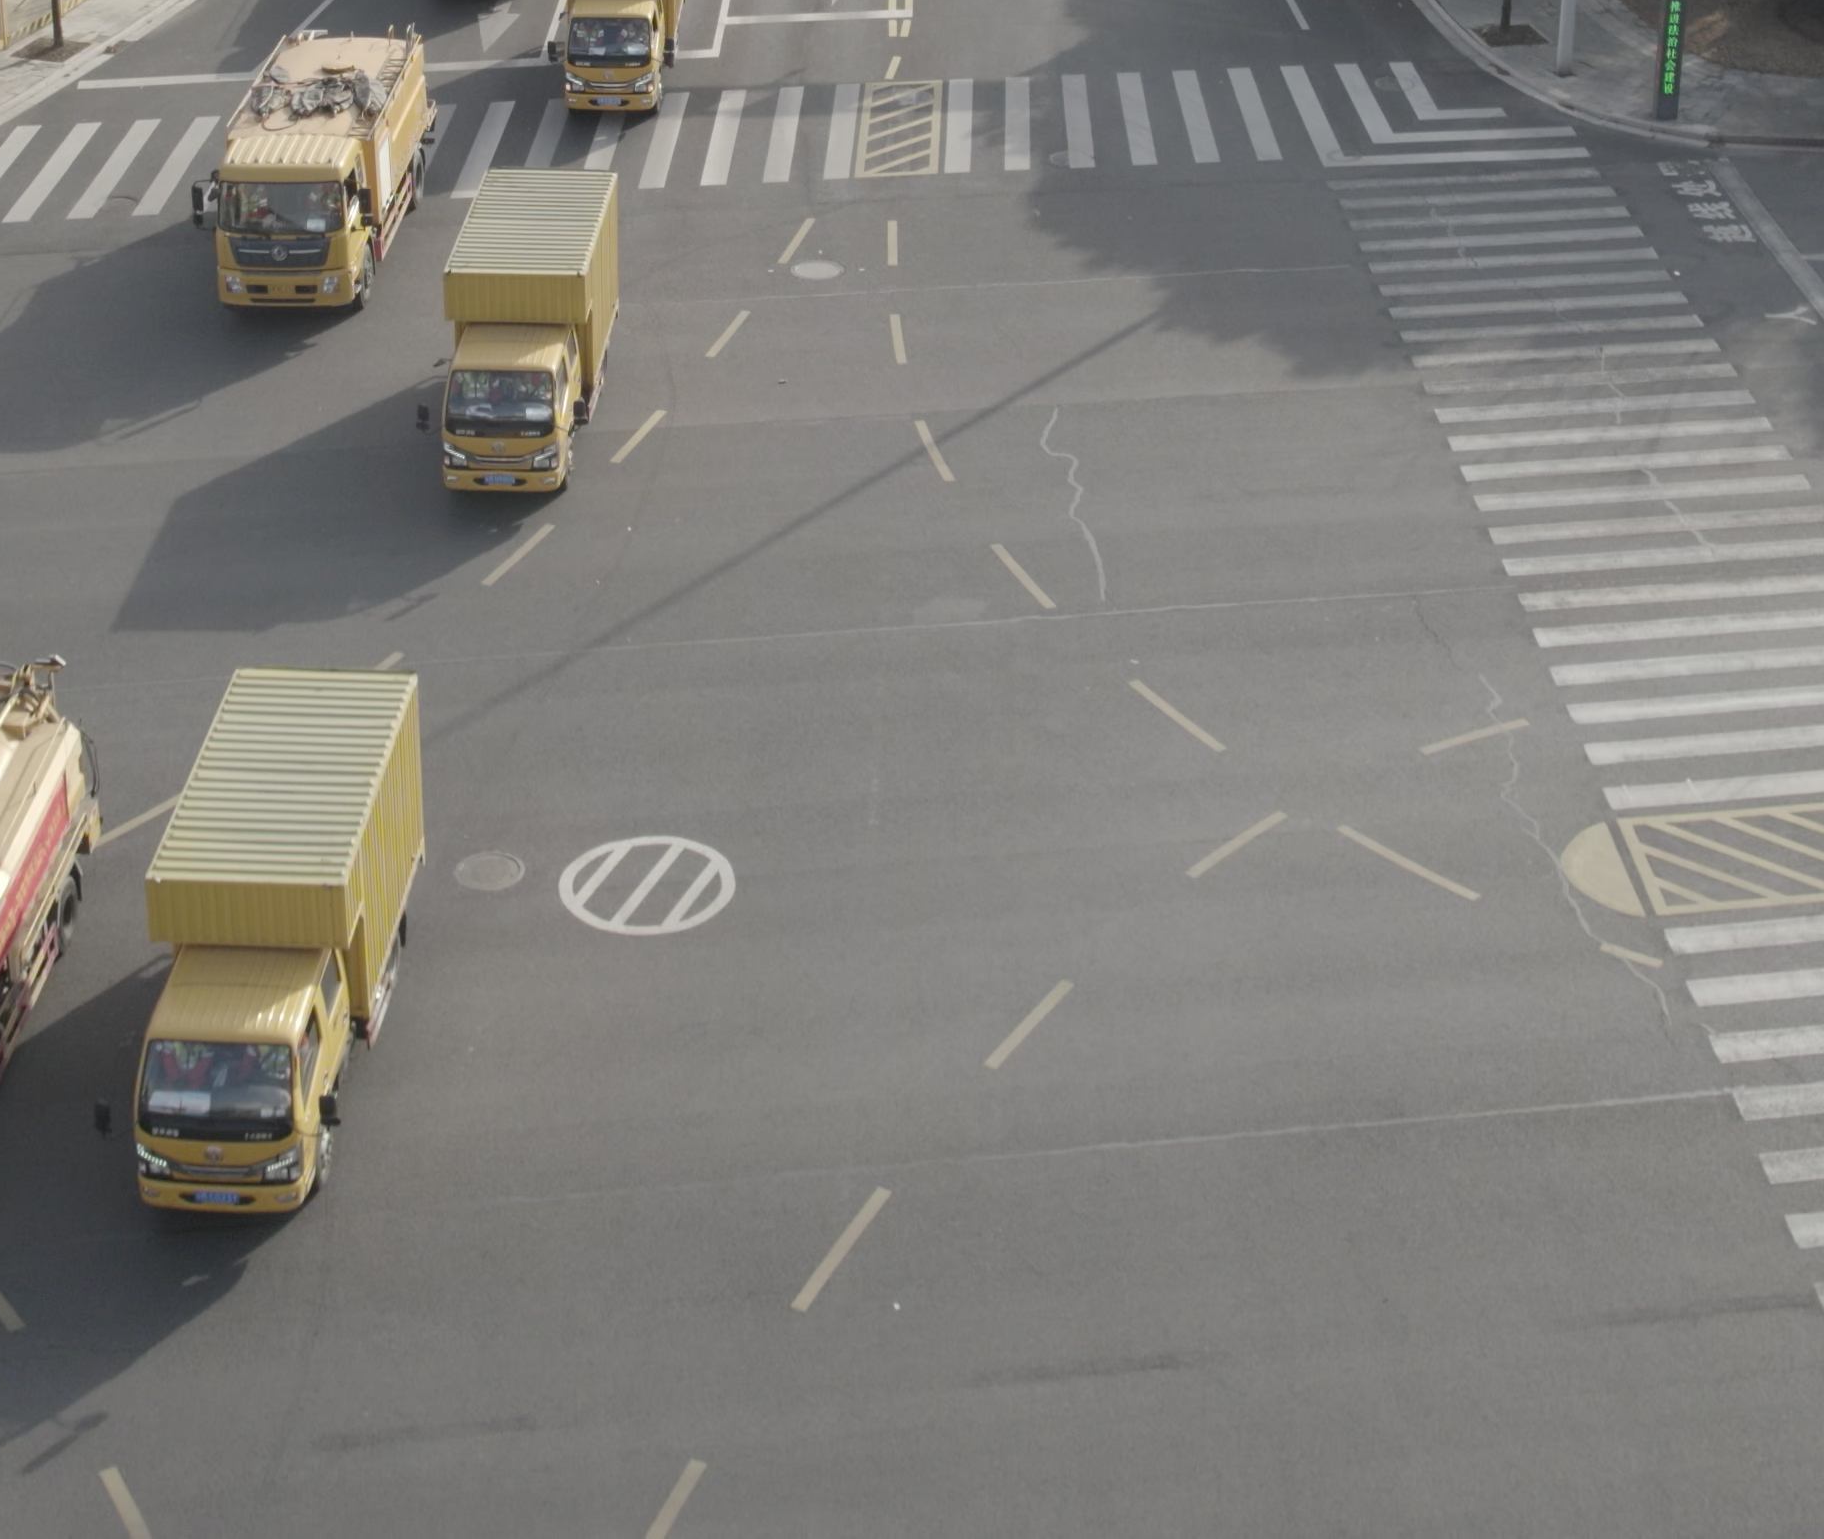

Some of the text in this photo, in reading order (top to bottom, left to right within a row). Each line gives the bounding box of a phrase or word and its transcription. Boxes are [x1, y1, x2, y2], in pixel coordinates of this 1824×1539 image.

[1664, 0, 1681, 95] 推进法治社会建设
